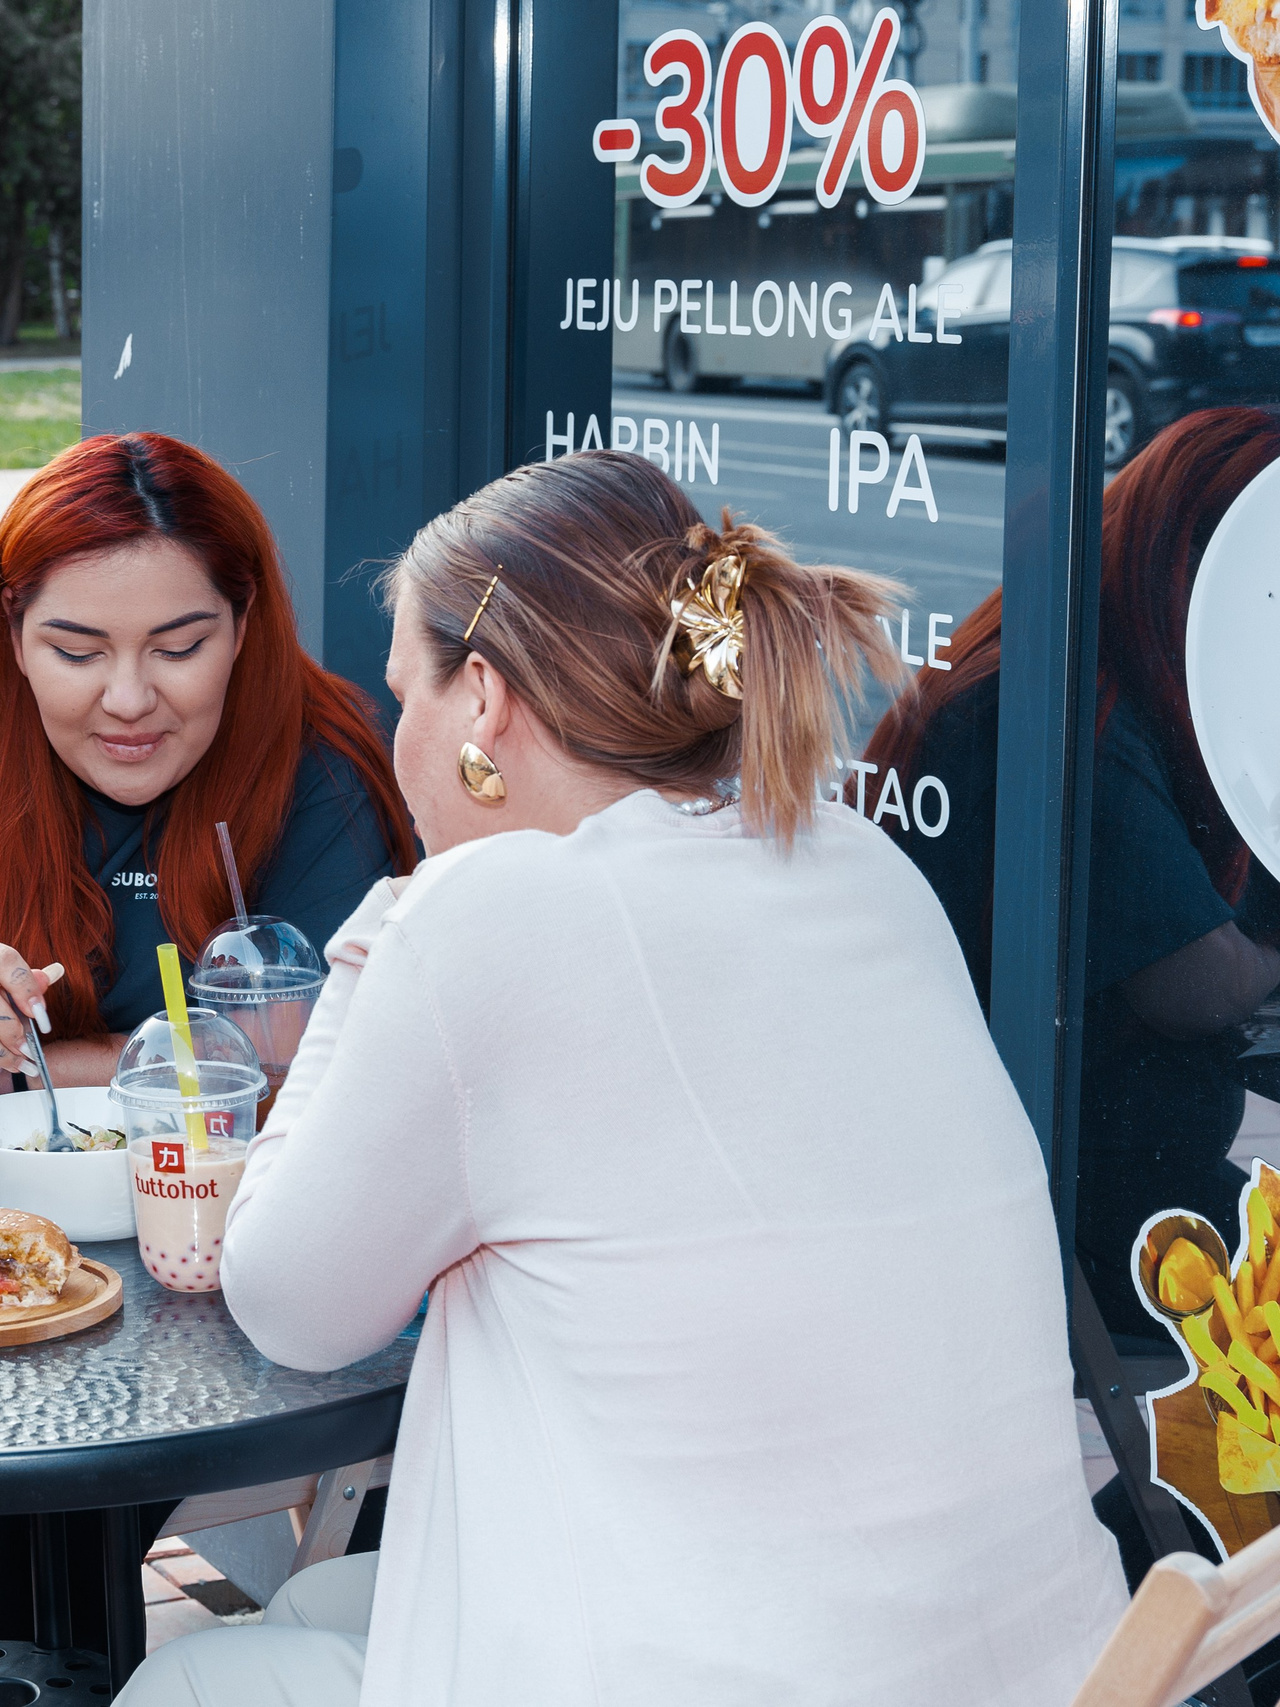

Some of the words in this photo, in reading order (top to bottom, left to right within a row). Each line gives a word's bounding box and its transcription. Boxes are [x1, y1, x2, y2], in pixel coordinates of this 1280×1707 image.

[592, 7, 926, 209] -30%
[560, 277, 640, 333] JEJU
[653, 279, 853, 341] PELLONG
[868, 282, 963, 345] ALE
[828, 427, 939, 523] IPA
[134, 892, 148, 900] EST.
[135, 1172, 219, 1199] tuttohot
